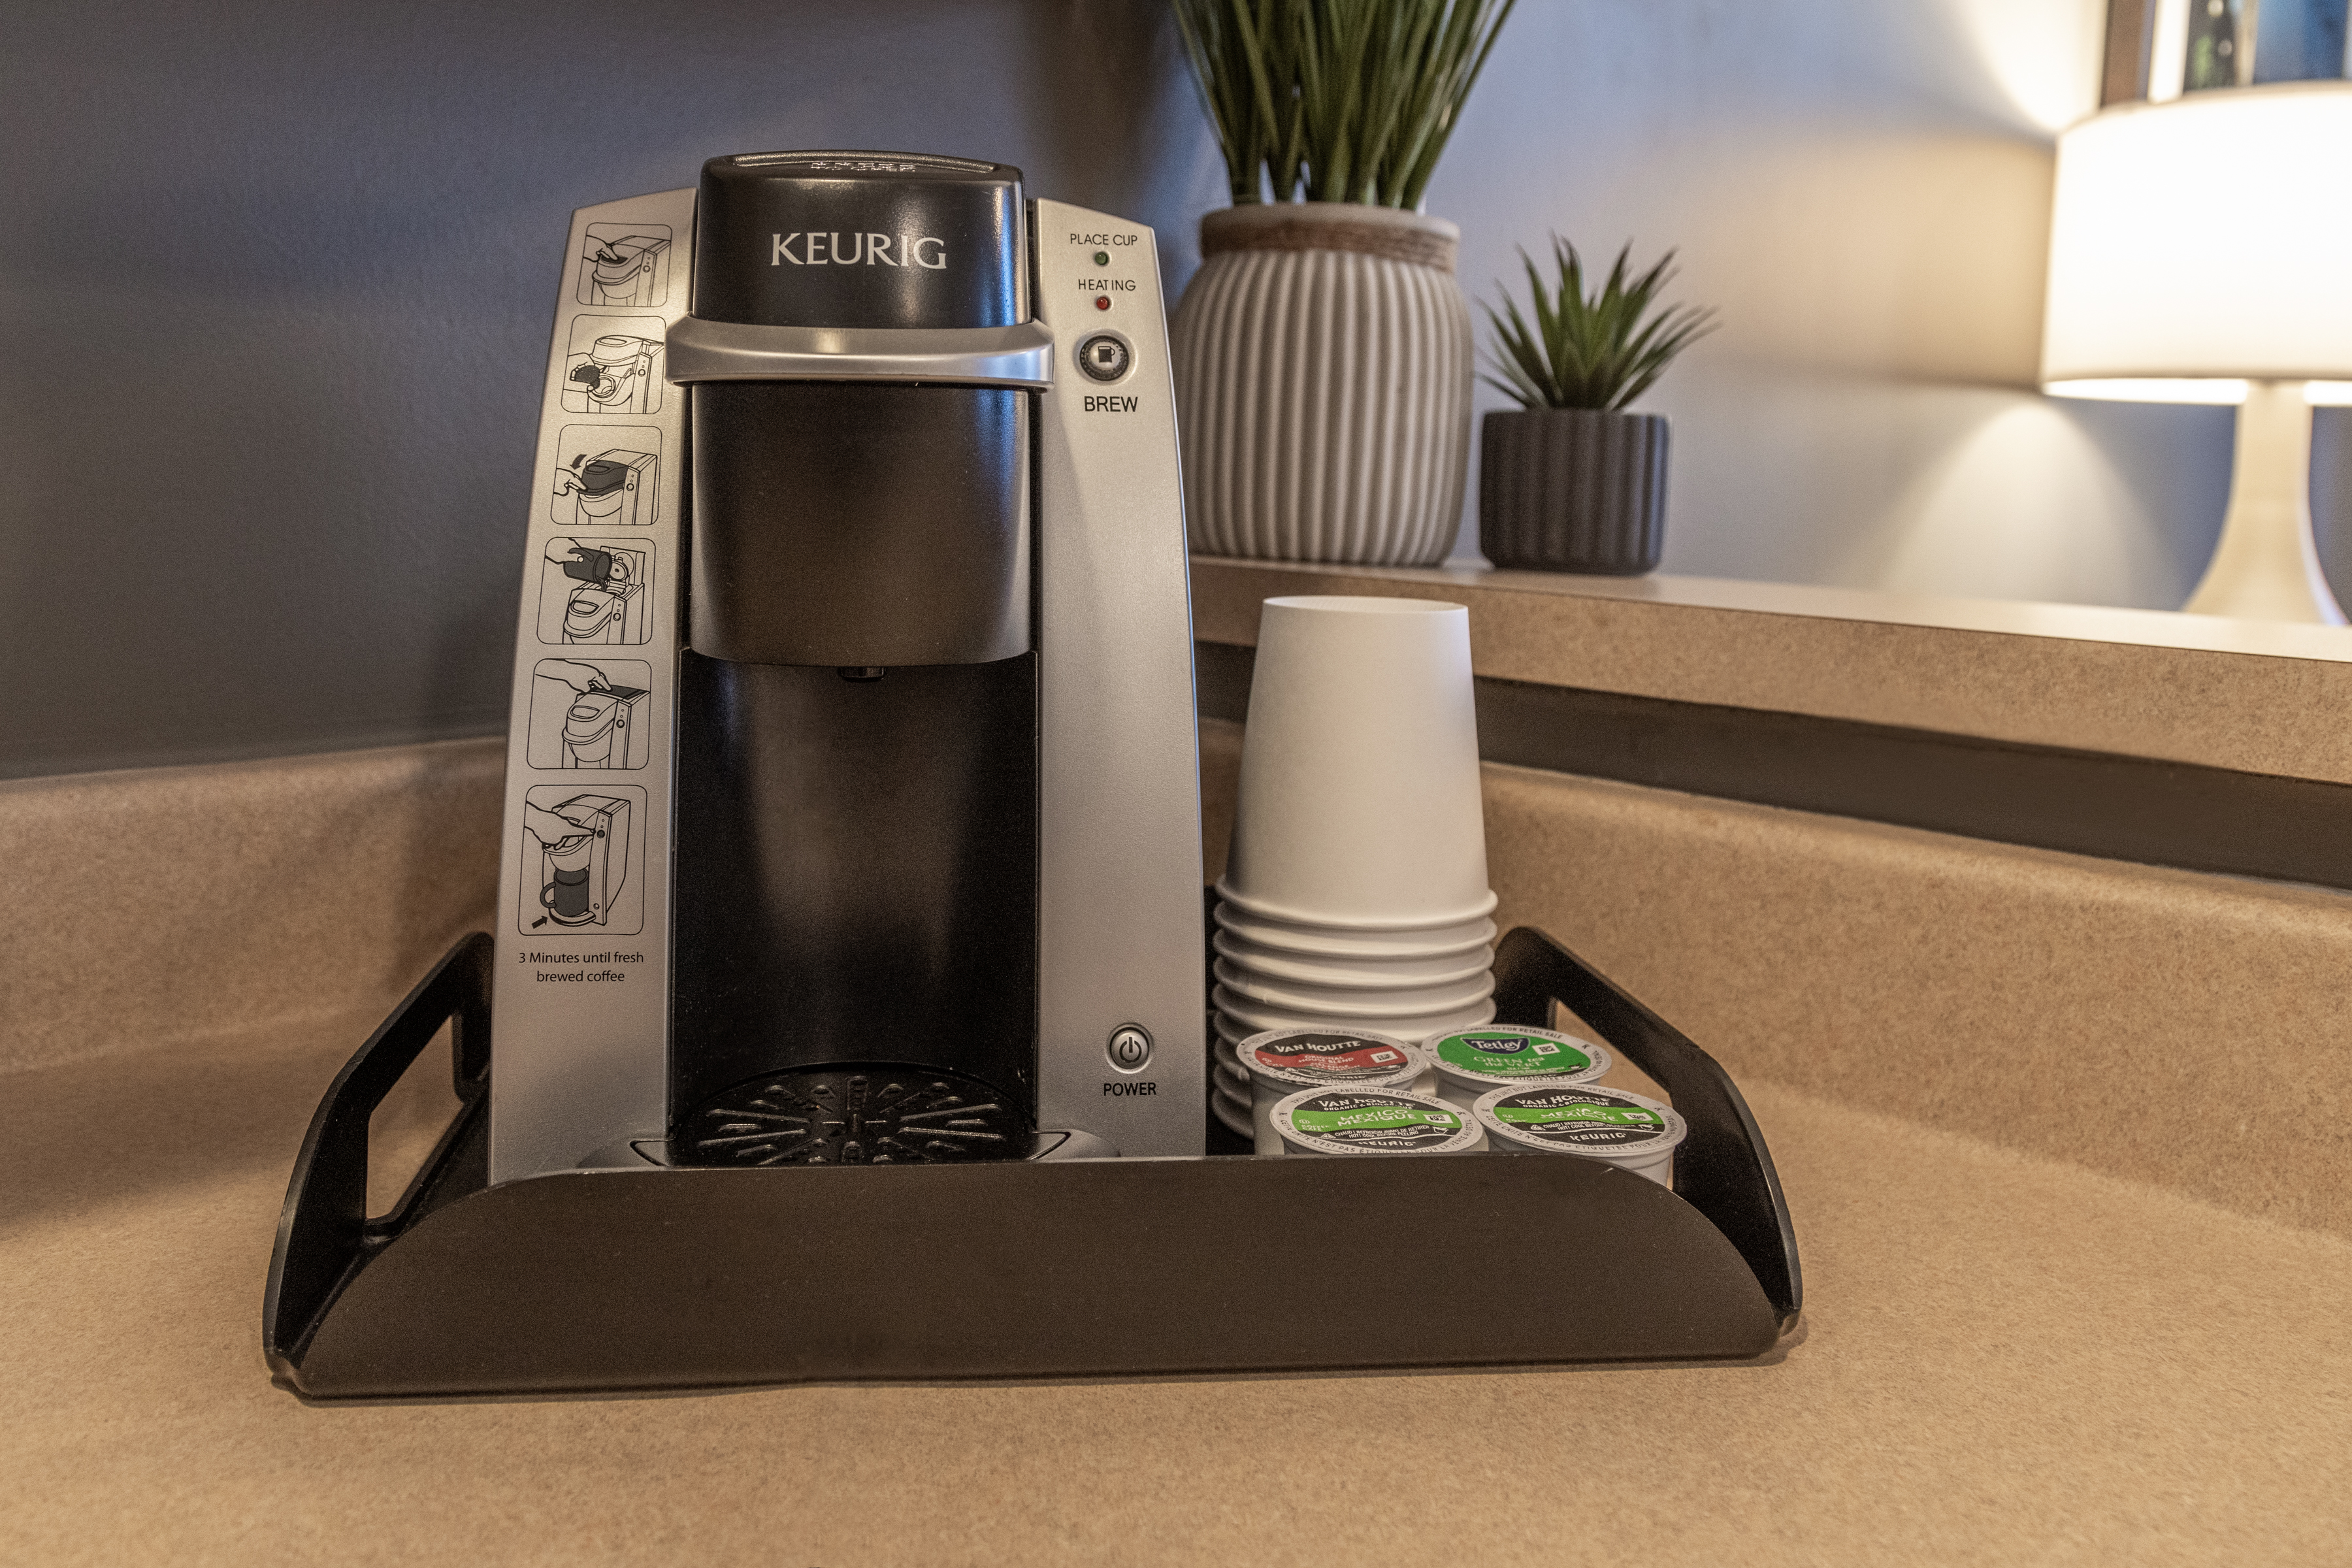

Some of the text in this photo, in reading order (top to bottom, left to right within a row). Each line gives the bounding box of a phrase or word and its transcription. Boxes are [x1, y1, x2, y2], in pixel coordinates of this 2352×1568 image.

[1070, 233, 1138, 246] PLACE CUP
[771, 232, 947, 269] KEURIG
[1078, 278, 1137, 291] HEATING
[1083, 396, 1139, 412] BREW
[518, 951, 644, 964] 3 Minutes until fresh
[536, 970, 625, 982] brewed coffee
[1274, 1040, 1361, 1053] VAN HOUTTE
[1471, 1039, 1523, 1051] Tetley
[1103, 1082, 1157, 1096] POWER
[1396, 1091, 1420, 1100] RETAIL
[1587, 1087, 1614, 1096] RETAIL
[1318, 1098, 1416, 1107] VAN HOUTTE
[1550, 1094, 1610, 1104] HOUTTE
[1337, 1113, 1417, 1126] MEXIQUE
[1339, 1109, 1408, 1122] MEXICO
[1569, 1132, 1626, 1141] KEURIG
[1312, 1138, 1337, 1149] N'EST
